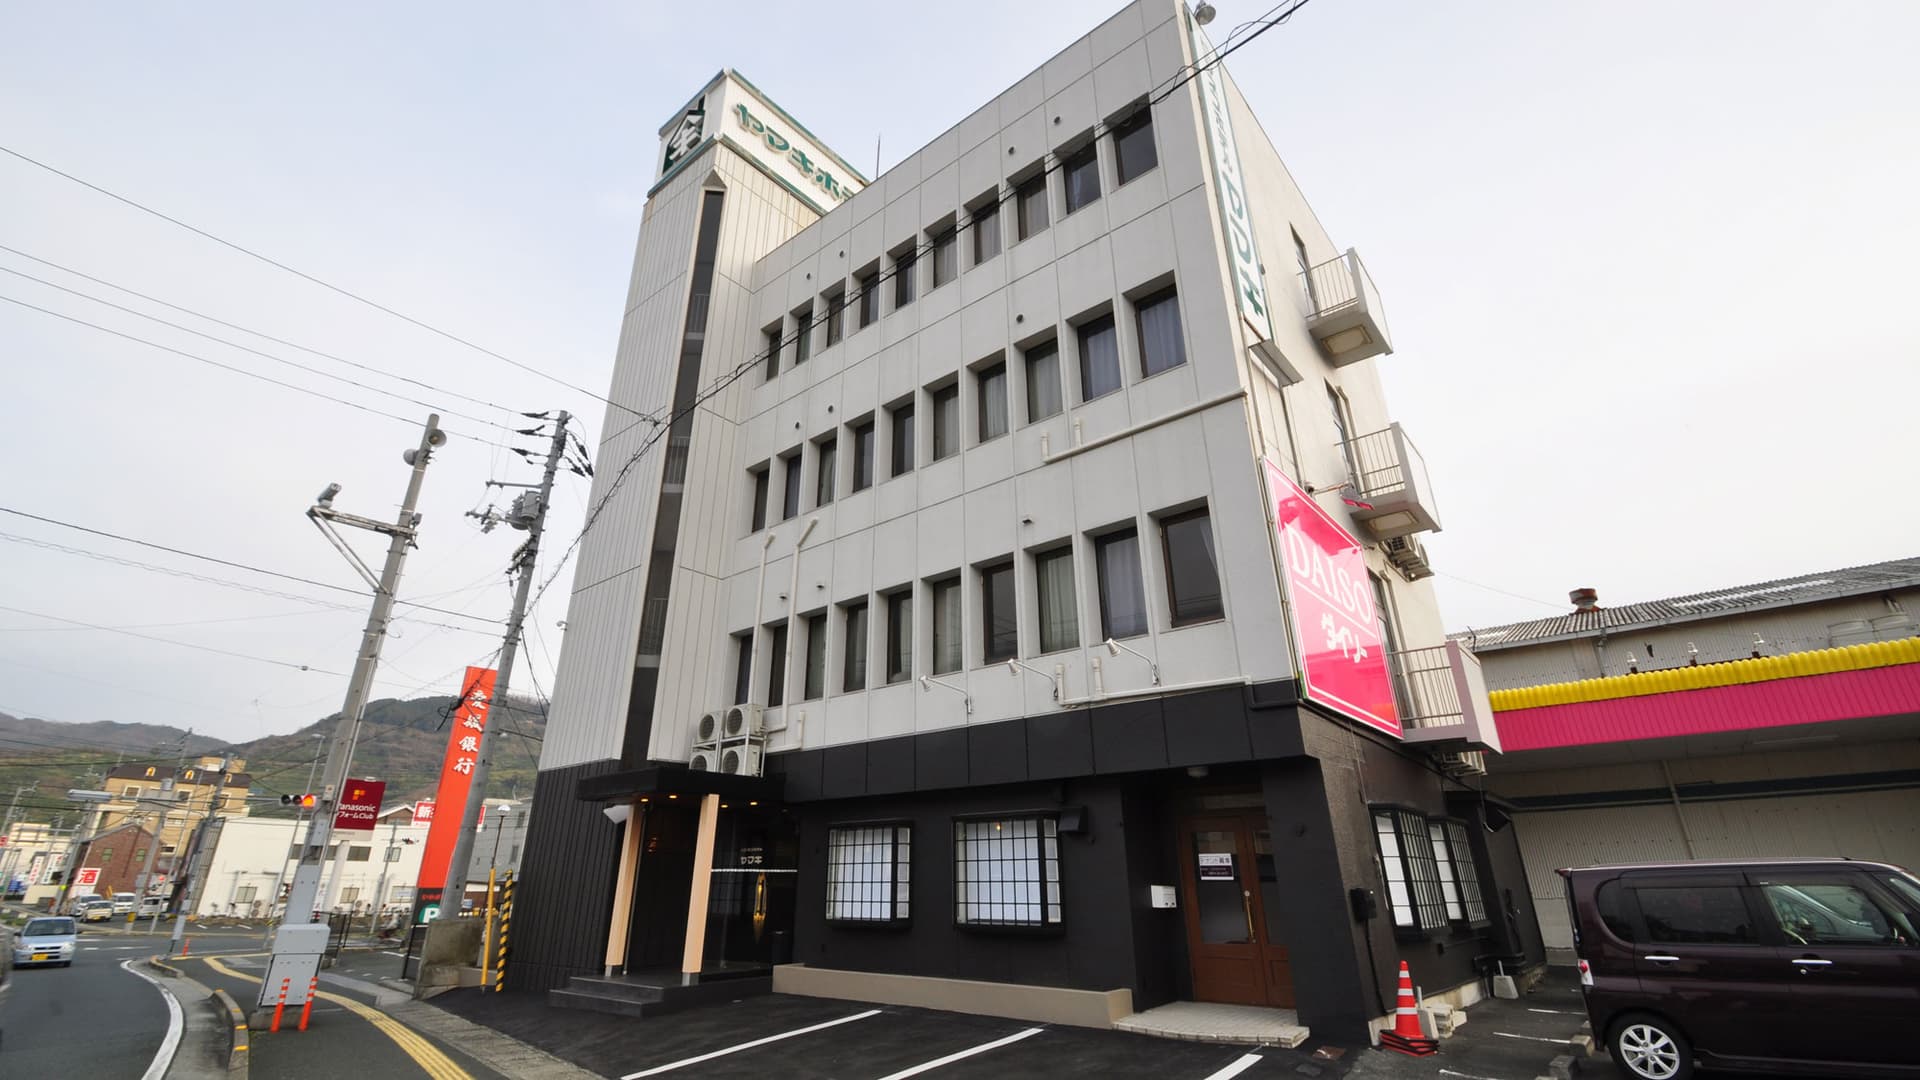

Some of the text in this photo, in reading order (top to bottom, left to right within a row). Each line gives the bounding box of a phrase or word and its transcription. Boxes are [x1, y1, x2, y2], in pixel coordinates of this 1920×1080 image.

[1284, 521, 1371, 625] DAISO
[337, 811, 374, 819] フォームClub
[416, 805, 434, 818] 新
[78, 869, 99, 883] 酒
[423, 907, 440, 923] P
